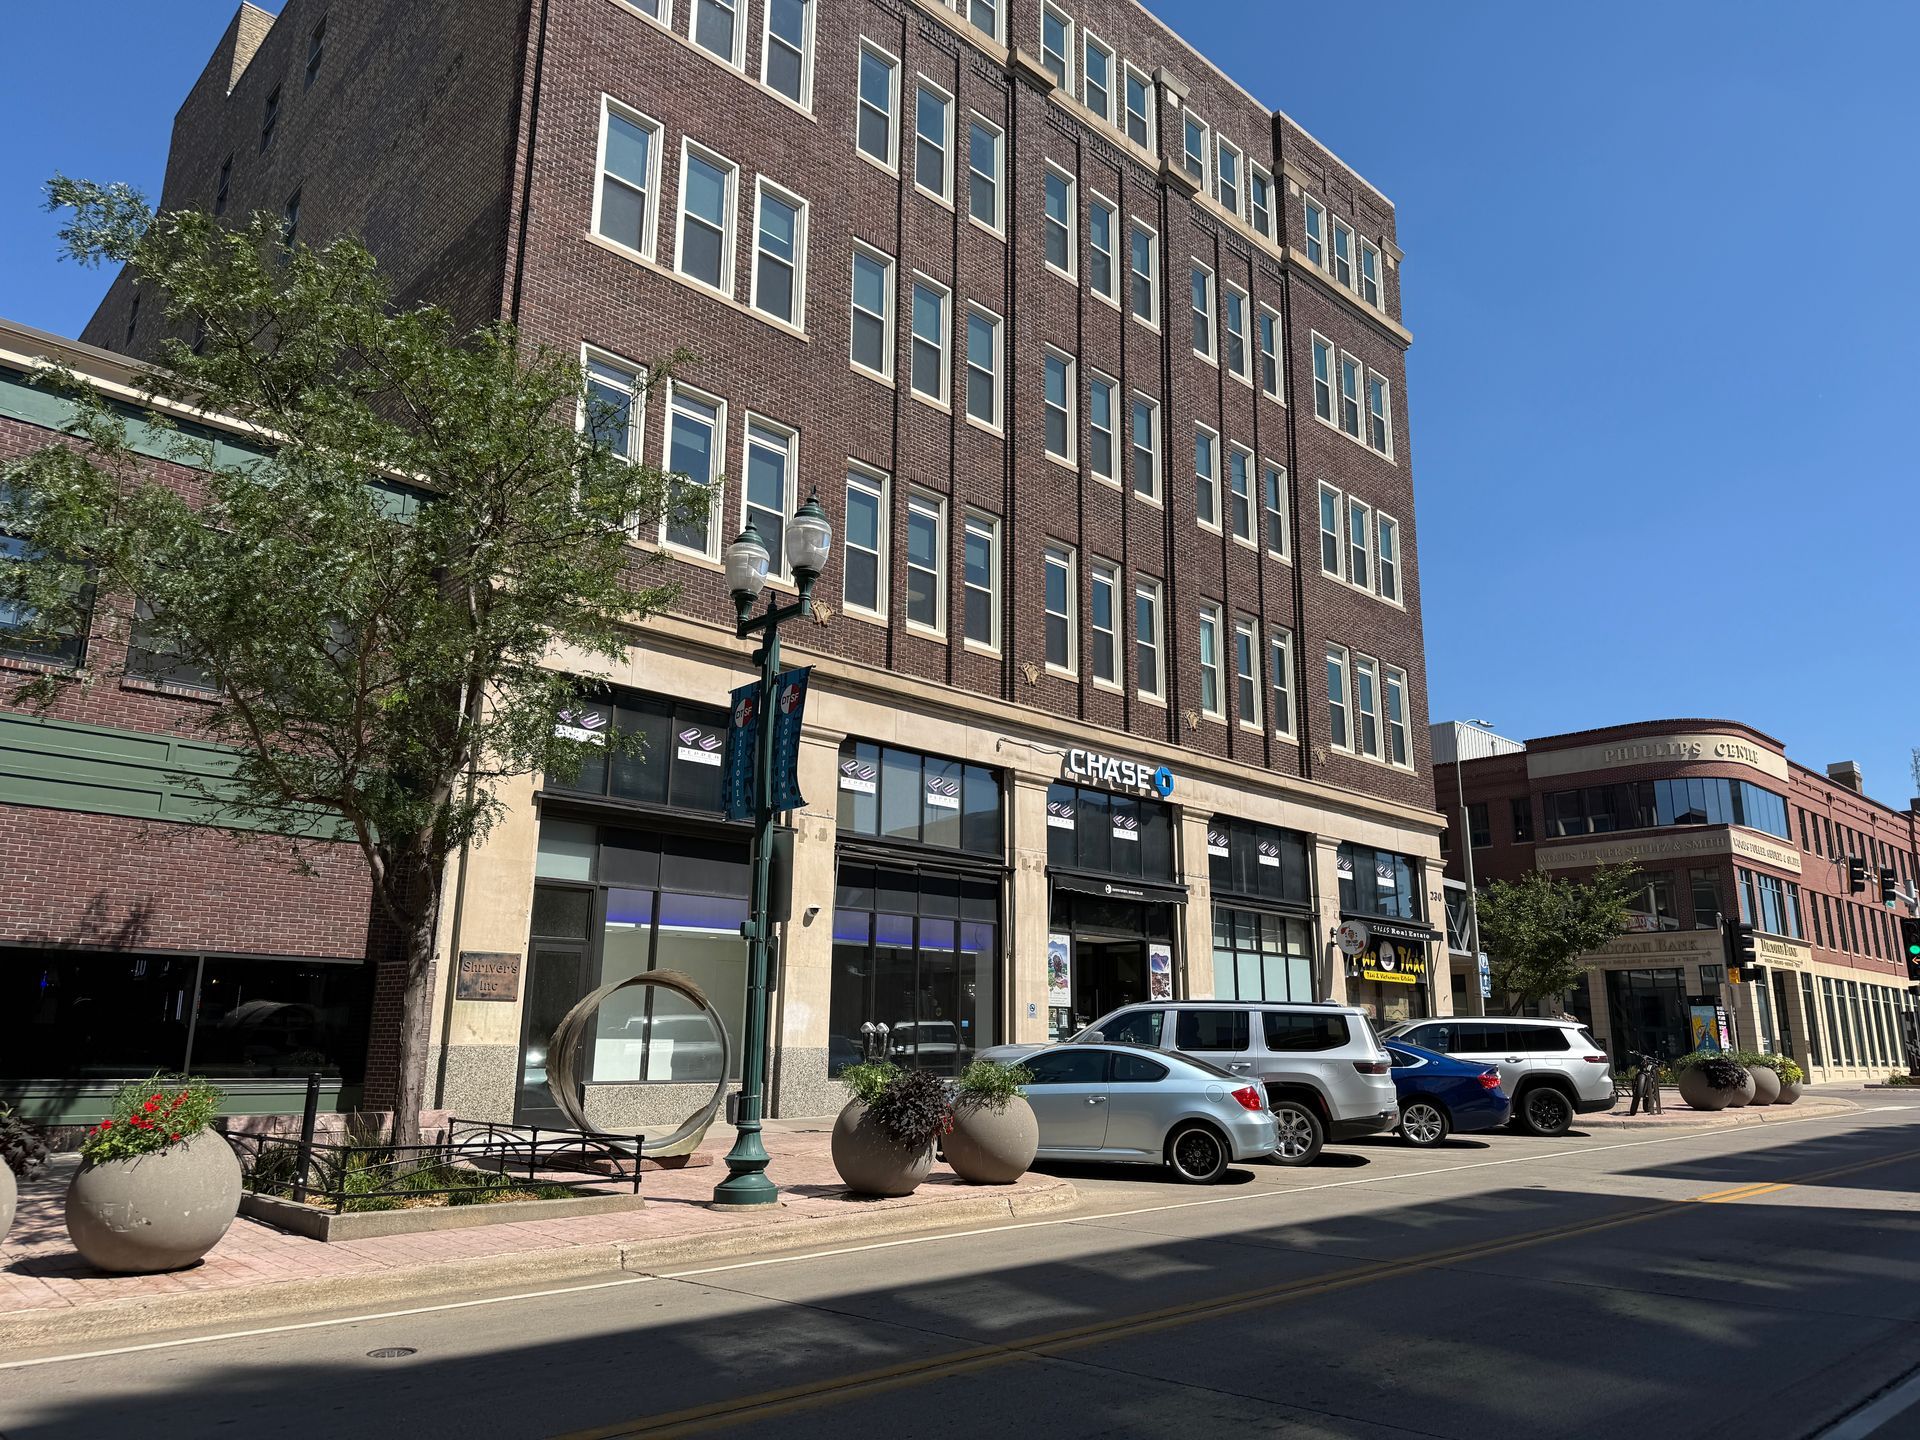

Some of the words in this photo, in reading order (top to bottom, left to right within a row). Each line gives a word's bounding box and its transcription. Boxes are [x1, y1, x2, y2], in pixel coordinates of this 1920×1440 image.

[781, 718, 789, 799] DOWNTOWN
[1605, 742, 1702, 762] PHILLIPS
[735, 731, 744, 807] HISTORIC
[1070, 749, 1155, 789] CHASE
[1686, 838, 1725, 848] SMITH
[463, 960, 518, 974] Shriver's
[480, 980, 498, 991] Inc
